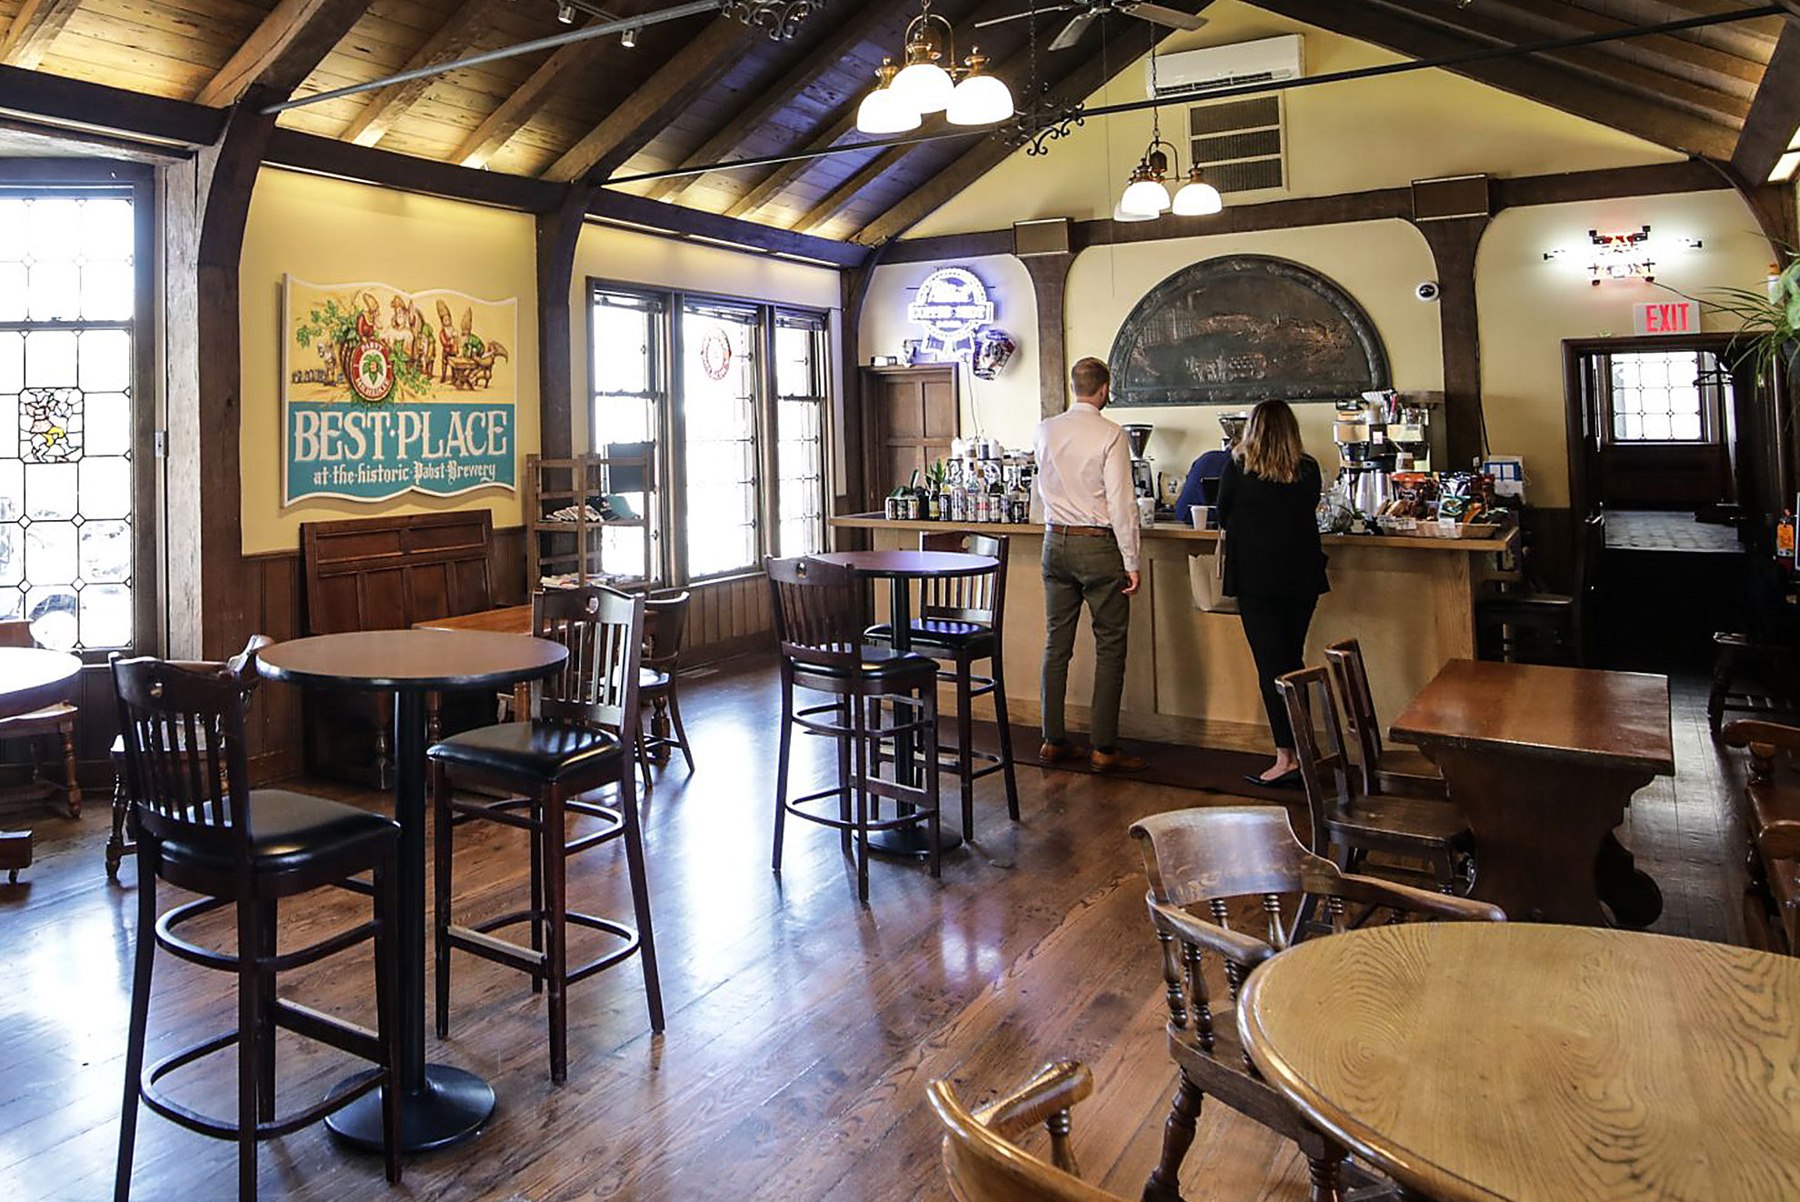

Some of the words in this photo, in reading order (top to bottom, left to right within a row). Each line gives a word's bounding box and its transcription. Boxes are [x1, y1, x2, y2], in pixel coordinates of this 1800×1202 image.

[1645, 303, 1689, 332] EXIT
[396, 410, 508, 459] PLACE
[313, 466, 329, 485] at
[333, 463, 355, 486] the
[358, 462, 409, 484] historic
[413, 461, 445, 485] Pabst
[446, 460, 496, 485] Brewery
